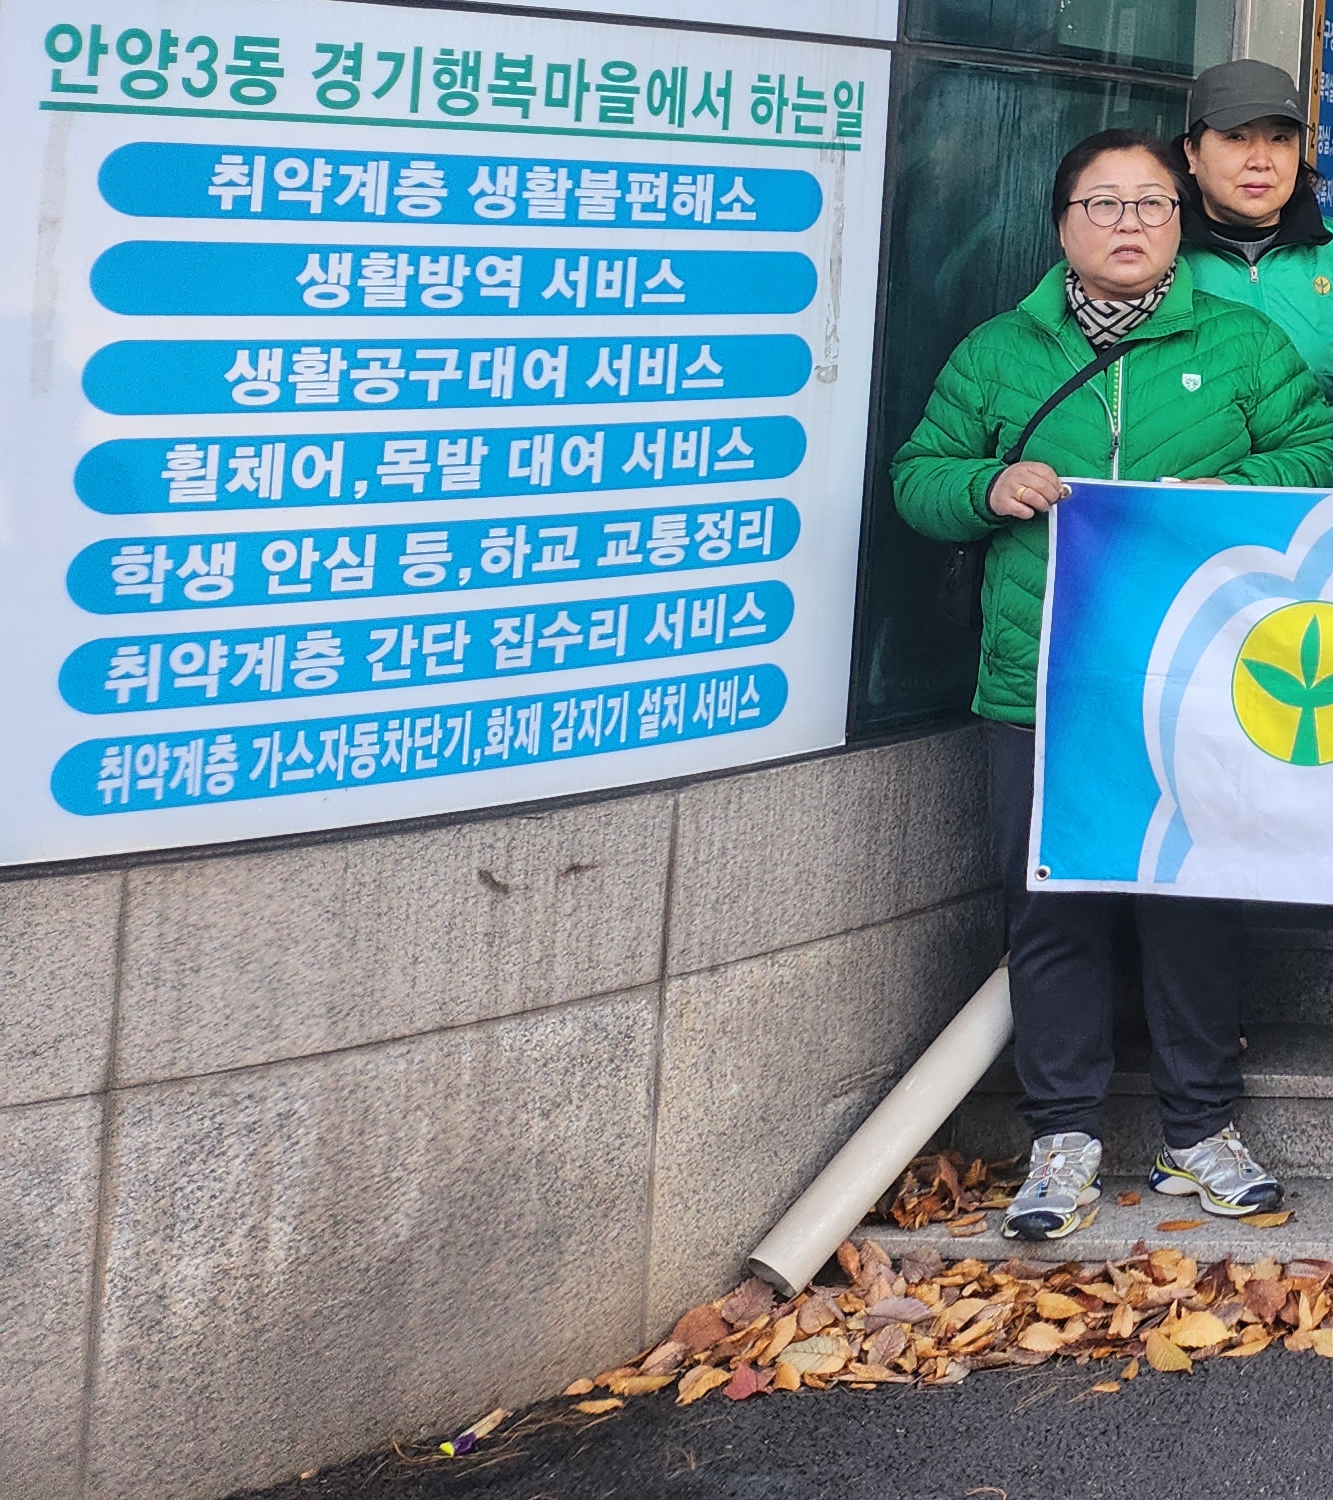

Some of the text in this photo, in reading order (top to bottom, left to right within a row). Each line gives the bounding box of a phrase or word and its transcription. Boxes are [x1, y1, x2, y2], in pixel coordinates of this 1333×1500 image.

[43, 22, 286, 104] 안양3동
[310, 40, 733, 132] 경기행복마을에서
[207, 152, 759, 226] 취약계층 생활불편해소
[295, 252, 687, 310] 생활방역 서비스
[223, 342, 725, 407] 생활공구대여 서비스
[160, 426, 757, 504] 휠체어,목발 대여 서비스
[109, 506, 776, 603] 학생 안심 등,하교 교통정리
[104, 594, 769, 705] 취약계층 간단 집수리 서비스
[96, 673, 762, 805] 취약계층 가스자동차단기,화재 감지기 설치 서비스
